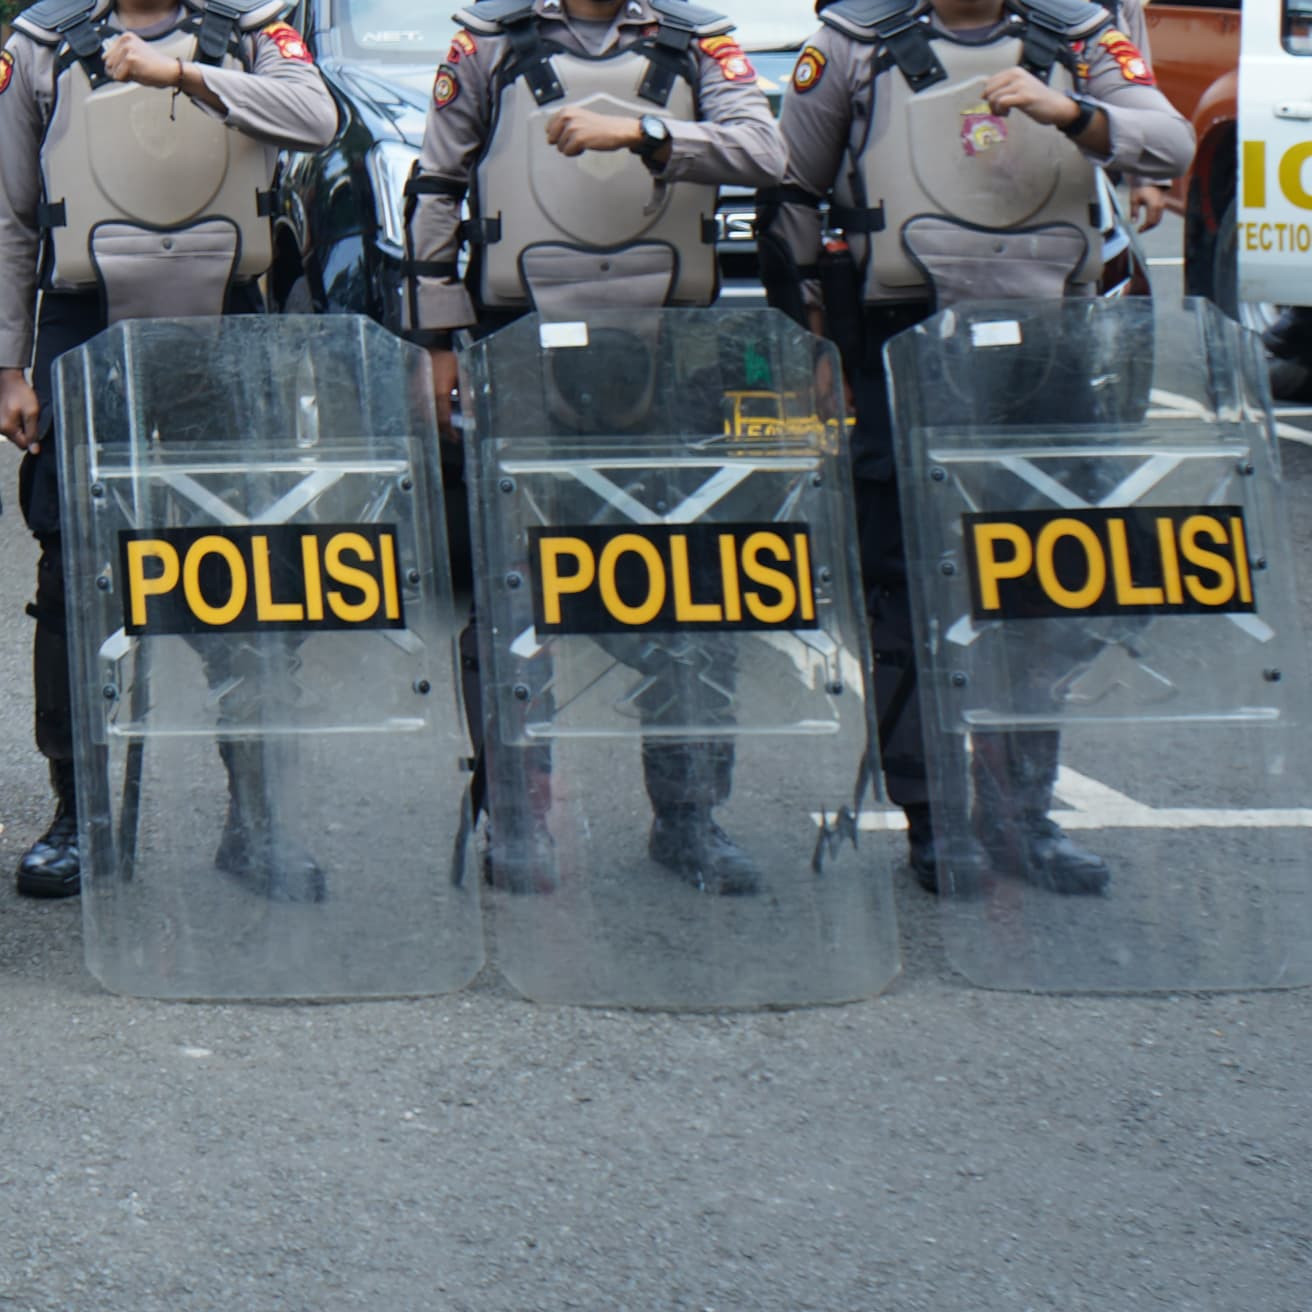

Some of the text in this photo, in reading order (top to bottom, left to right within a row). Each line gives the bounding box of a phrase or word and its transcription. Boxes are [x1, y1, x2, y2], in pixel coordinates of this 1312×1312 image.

[127, 532, 400, 625] POLISI
[538, 532, 814, 625] POLISI
[973, 515, 1253, 609] POLISI
